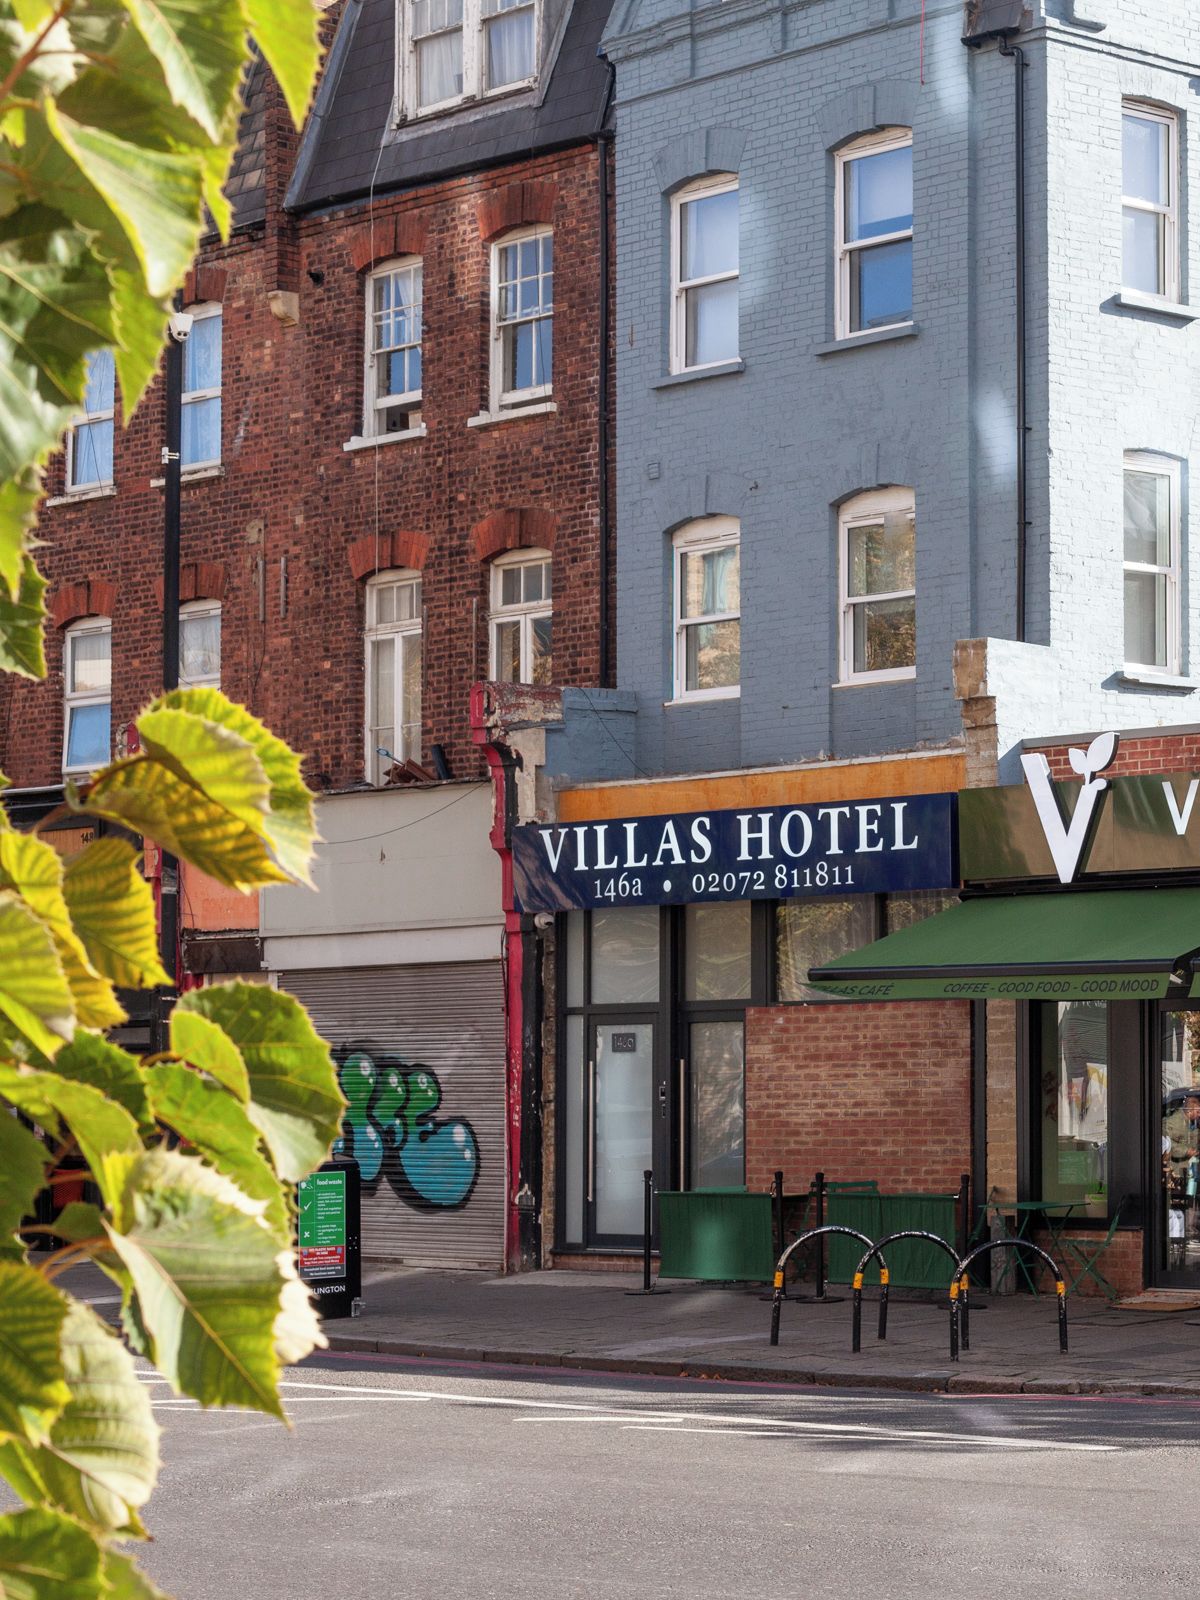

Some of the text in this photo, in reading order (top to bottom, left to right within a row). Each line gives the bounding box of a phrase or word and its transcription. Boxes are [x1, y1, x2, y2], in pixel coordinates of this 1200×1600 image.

[538, 802, 919, 873] VILLAS HOTEL
[594, 862, 855, 902] 146a 02072 811811
[858, 983, 895, 995] CAFÉ
[943, 983, 989, 993] COFFEE
[998, 982, 1034, 993] GOOD
[1036, 981, 1072, 993] FOOD
[1080, 980, 1117, 993] GOOD
[1118, 979, 1160, 992] MOOD
